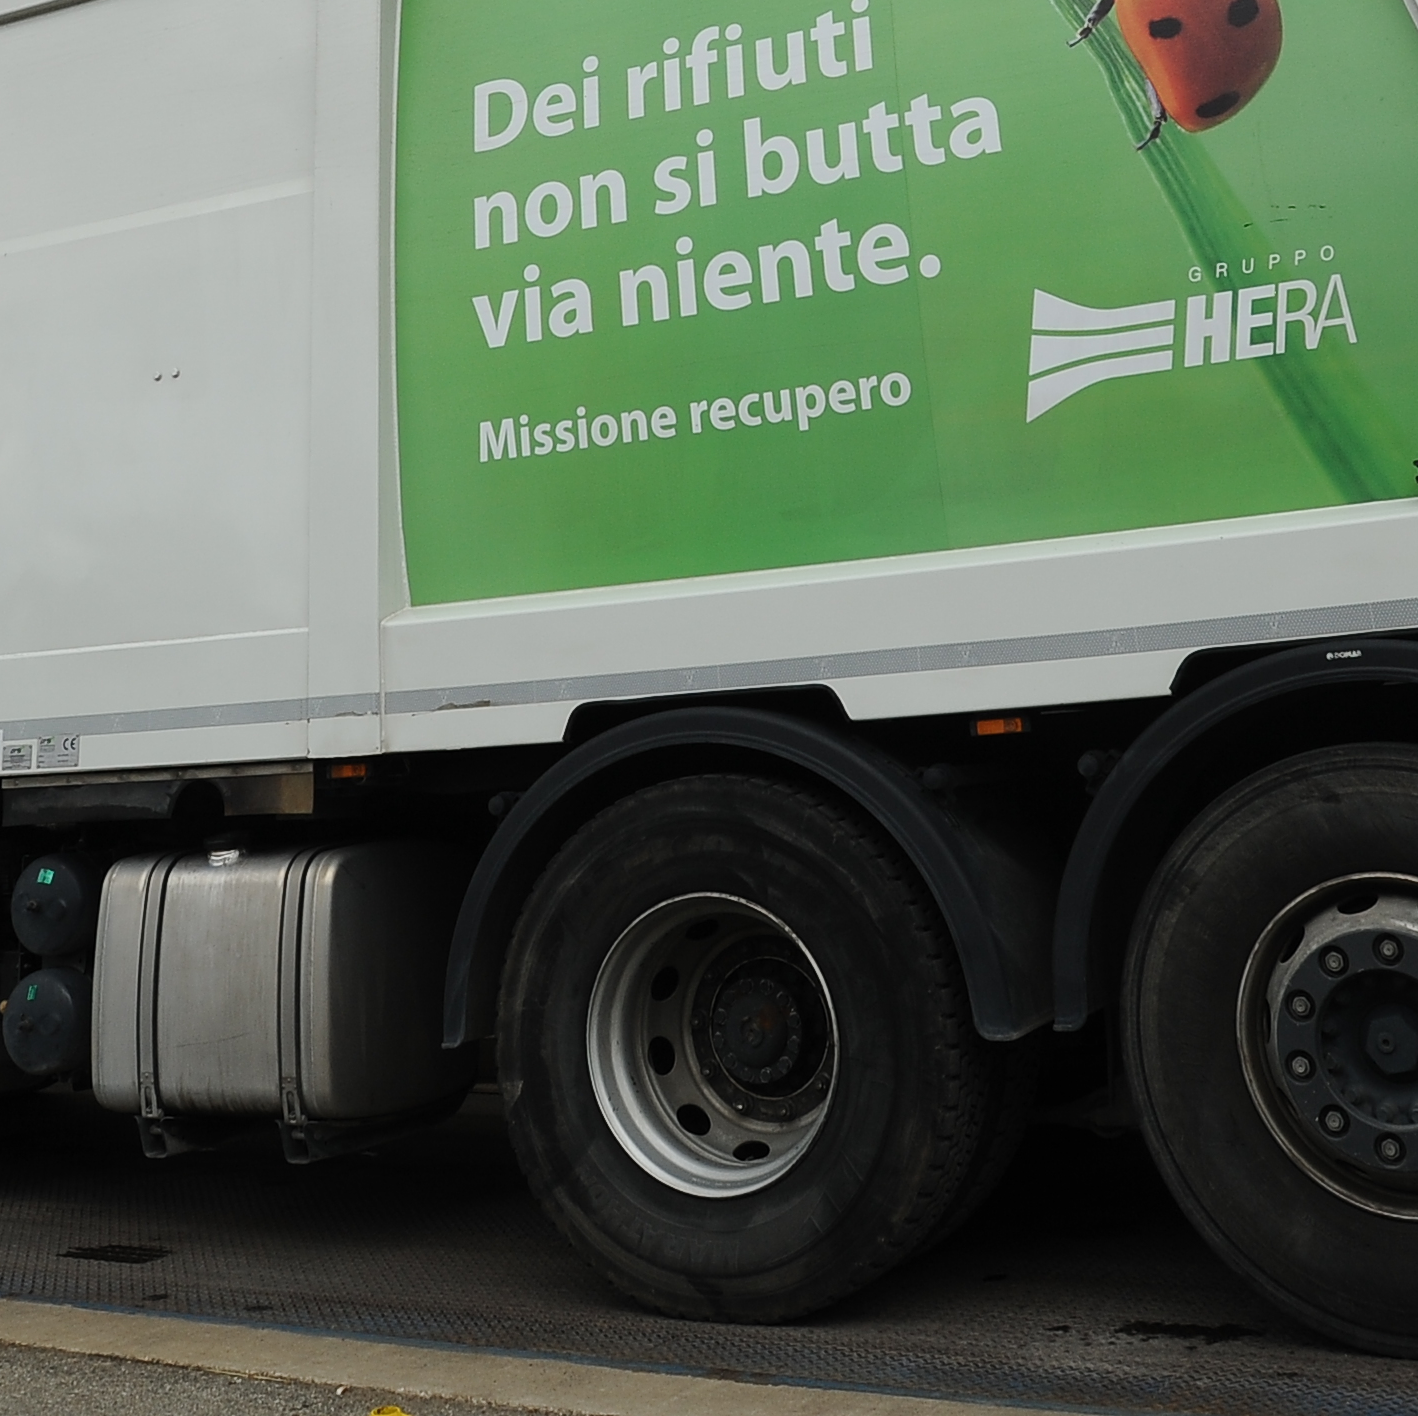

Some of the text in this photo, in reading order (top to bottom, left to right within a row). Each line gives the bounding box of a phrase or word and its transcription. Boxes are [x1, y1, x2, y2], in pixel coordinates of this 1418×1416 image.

[473, 55, 600, 153] Dei
[473, 93, 1003, 250] non si butta
[471, 217, 942, 349] via niente.
[1188, 245, 1334, 282] GRUPPO
[1184, 274, 1358, 368] HERA
[479, 371, 912, 462] Missione recupero
